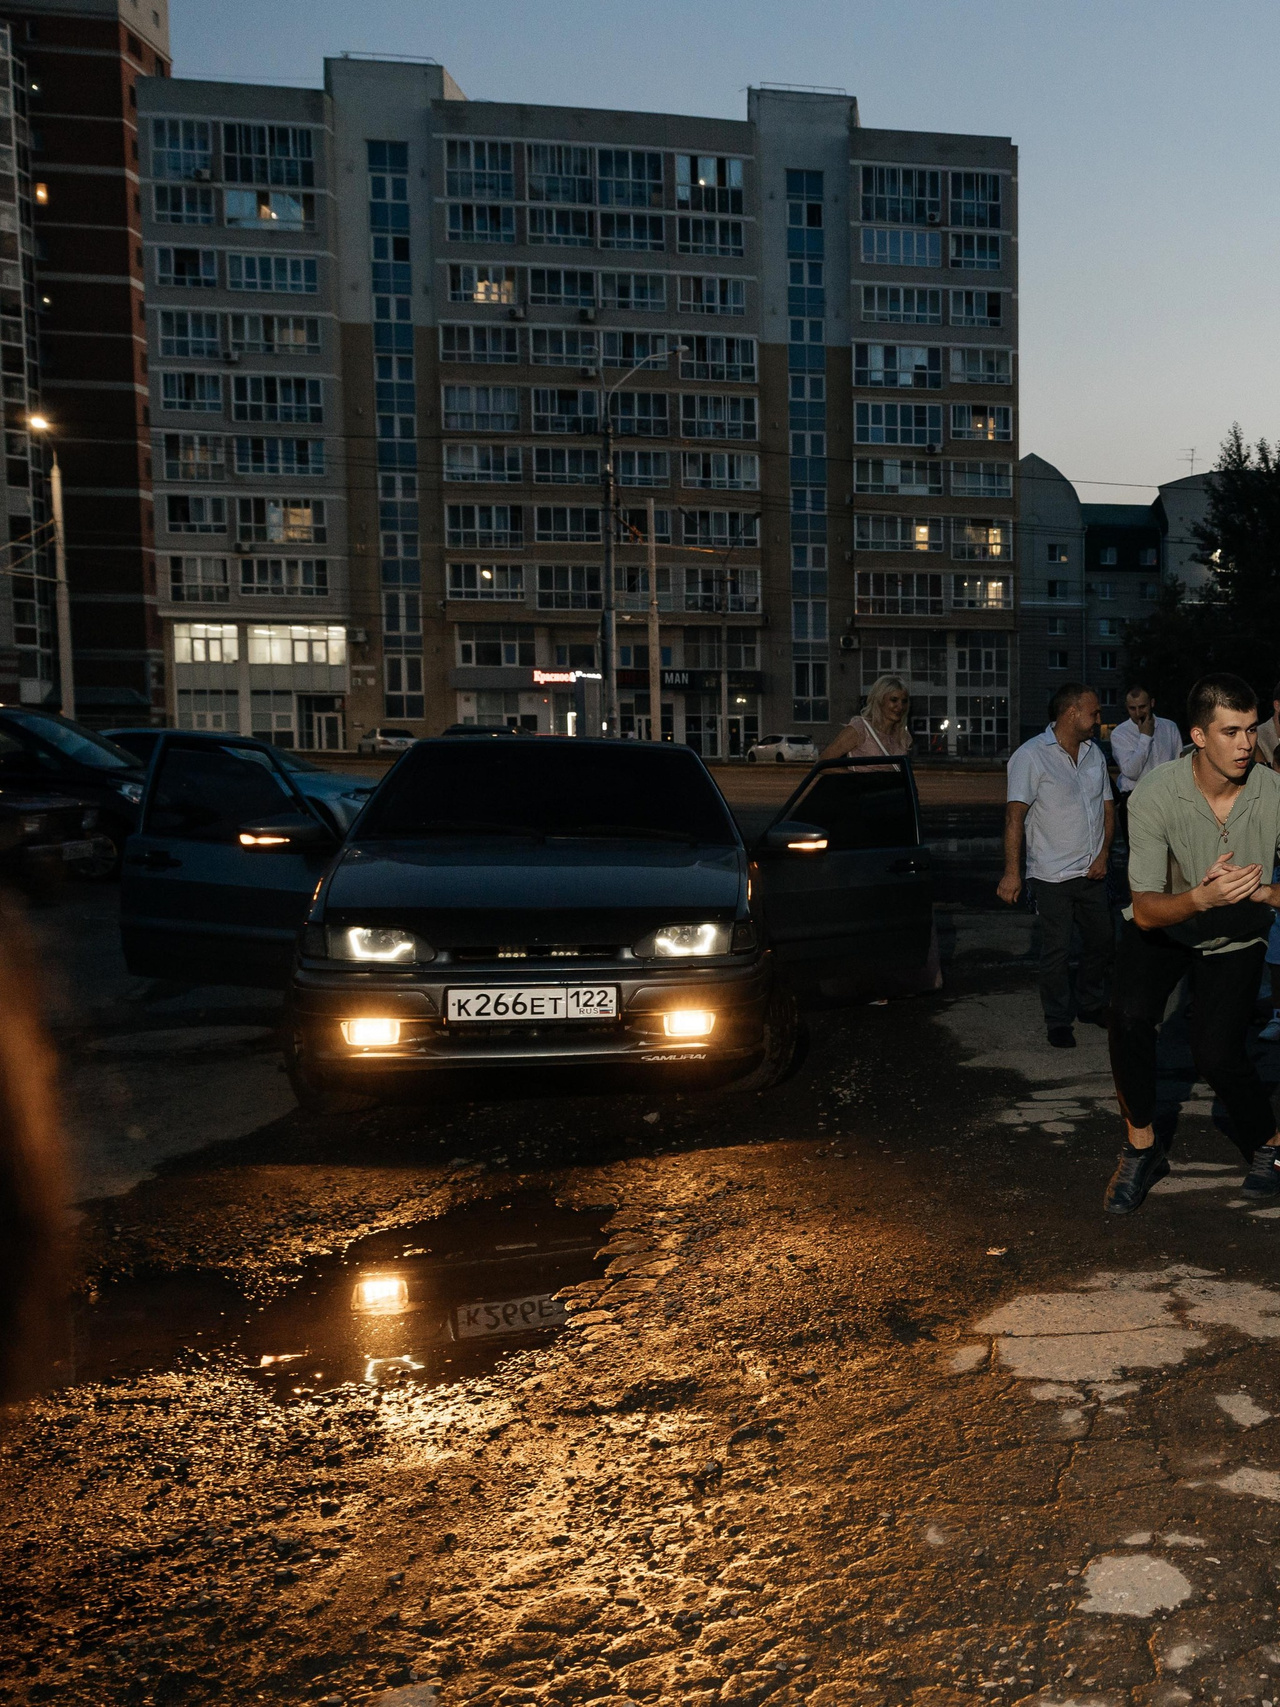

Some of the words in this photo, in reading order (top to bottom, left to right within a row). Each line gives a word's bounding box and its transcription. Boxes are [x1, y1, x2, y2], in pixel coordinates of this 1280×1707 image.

[664, 672, 689, 685] MAN
[457, 992, 563, 1017] К266ЕТ
[570, 990, 608, 1008] 122
[641, 1053, 707, 1061] SAMURAI
